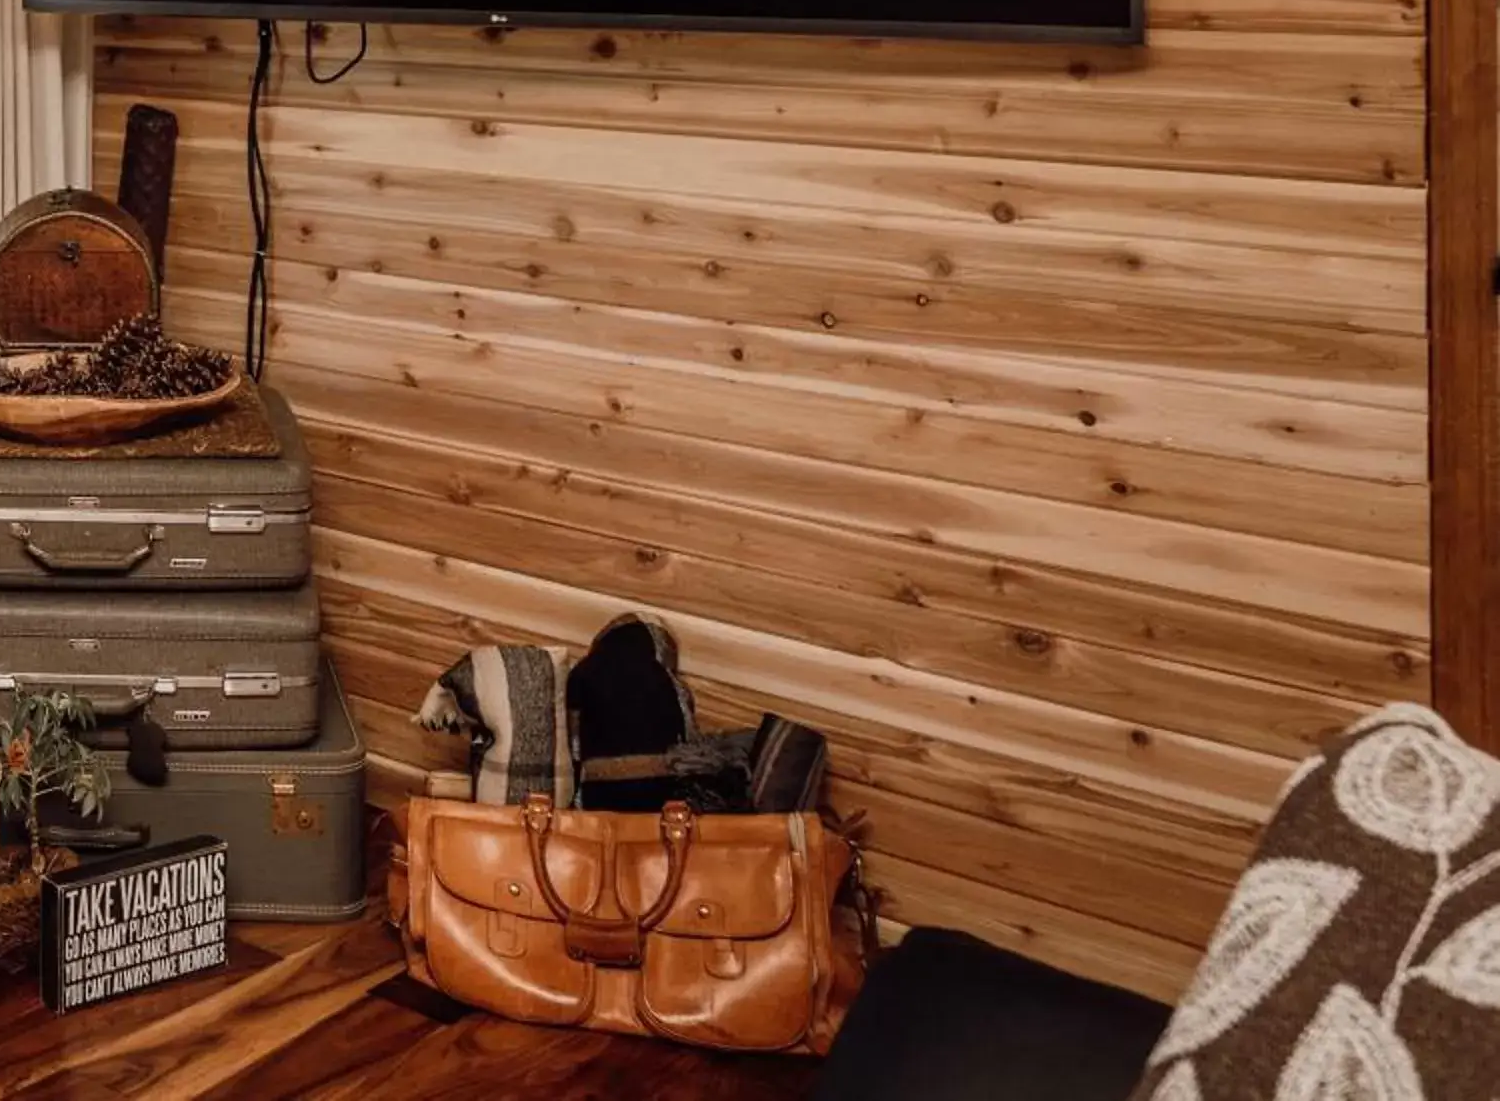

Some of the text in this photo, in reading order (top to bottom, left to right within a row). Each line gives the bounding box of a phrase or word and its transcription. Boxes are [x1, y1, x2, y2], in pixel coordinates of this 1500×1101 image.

[65, 852, 225, 936] TAKE VACATIONS
[65, 895, 225, 961] GO AS MANY PLACES AS YOU CAN
[65, 962, 83, 984] YOU
[104, 943, 141, 973] ALWAYS
[142, 935, 167, 962] MAKE
[169, 927, 194, 954] MORE
[195, 918, 225, 948] MONEY
[65, 942, 225, 1008] YOU CAN'T ALWAYS MAKE MEMORIES
